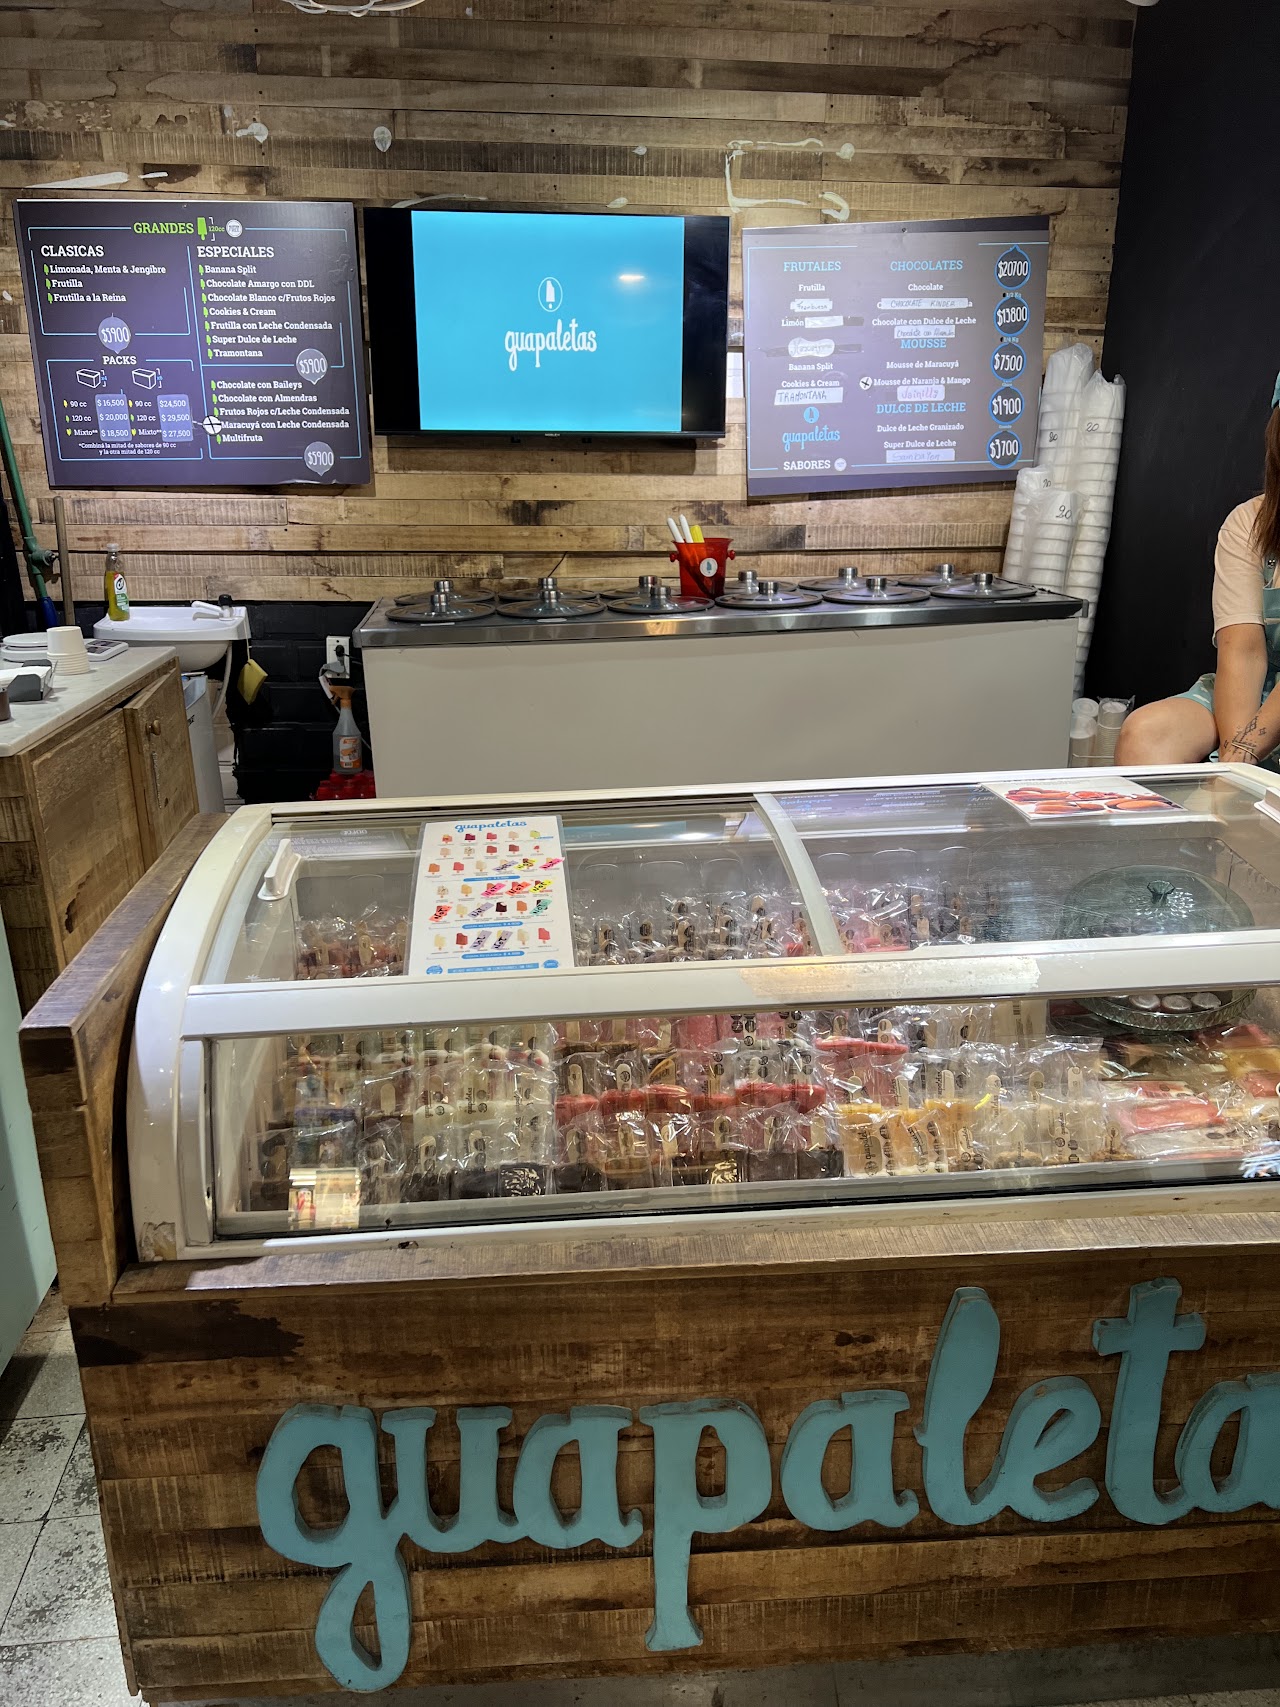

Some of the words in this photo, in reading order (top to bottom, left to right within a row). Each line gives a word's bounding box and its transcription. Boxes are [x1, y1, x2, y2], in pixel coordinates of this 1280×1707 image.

[134, 222, 194, 234] GRANDES
[40, 245, 104, 257] CLASICAS
[197, 246, 274, 258] ESPECIALES
[50, 265, 93, 274] Limonada,
[130, 266, 166, 275] Jengibre
[205, 266, 236, 274] Banana
[238, 266, 256, 275] Split
[783, 261, 842, 272] FRUTALES
[890, 260, 964, 271] CHOCOLATES
[998, 260, 1028, 278] $20700
[52, 280, 83, 288] Frutilla
[206, 280, 246, 288] Chocolate
[248, 280, 280, 289] Amargo
[298, 280, 314, 288] DDL
[798, 284, 826, 292] Frutilla
[908, 283, 944, 291] Chocolate
[54, 293, 84, 302] Frutilla
[92, 294, 100, 302] la
[102, 294, 126, 302] Reina
[208, 294, 248, 302] Chocolate
[249, 294, 276, 302] Blanco
[278, 294, 312, 303] c/Frutos
[313, 294, 336, 303] Rojos
[209, 308, 242, 316] Cookies
[242, 308, 249, 316] &
[250, 308, 276, 316] Cream
[996, 306, 1028, 326] $13800
[210, 322, 241, 330] Frutilla
[259, 322, 282, 330] Leche
[284, 322, 332, 330] Condensada
[872, 318, 907, 326] Chocolate
[101, 327, 130, 343] $5900
[212, 336, 236, 345] Super
[238, 336, 260, 344] Dulce
[262, 336, 272, 344] de
[273, 336, 297, 344] Leche
[504, 318, 597, 371] guapaletas
[900, 339, 946, 348] MOUSSE
[214, 349, 263, 357] Tramontana
[102, 356, 136, 364] PACKS
[924, 360, 959, 369] Maracuyá
[994, 353, 1023, 371] $7500
[300, 358, 326, 374] $5900
[816, 362, 833, 371] Split
[216, 380, 256, 389] Chocolate
[273, 381, 302, 390] Baileys
[782, 380, 809, 388] Cookies
[874, 378, 900, 386] Mousse
[912, 377, 939, 386] Naranja
[947, 377, 970, 385] Mango
[218, 394, 258, 402] Chocolate
[274, 394, 318, 402] Almendras
[876, 404, 912, 414] DULCE
[914, 403, 928, 412] DE
[931, 402, 966, 412] LECHE
[992, 396, 1021, 415] $1900
[167, 414, 190, 422] 29,500
[220, 408, 246, 416] Frutos
[246, 408, 269, 418] Rojos
[270, 408, 300, 416] c/Leche
[302, 408, 350, 416] Condensada
[222, 420, 260, 430] Maracuyá
[302, 420, 350, 428] Condensada
[930, 423, 964, 431] Granizado
[1086, 422, 1100, 432] 20
[222, 434, 263, 442] Multifruta
[782, 425, 840, 452] guapaletas
[884, 441, 904, 449] Super
[906, 440, 925, 448] Dulce
[936, 439, 956, 447] Leche
[990, 439, 1018, 459] $3700
[308, 452, 334, 466] $5900
[783, 460, 830, 470] SABORES
[1056, 505, 1072, 519] 20
[454, 820, 527, 832] guapaletas
